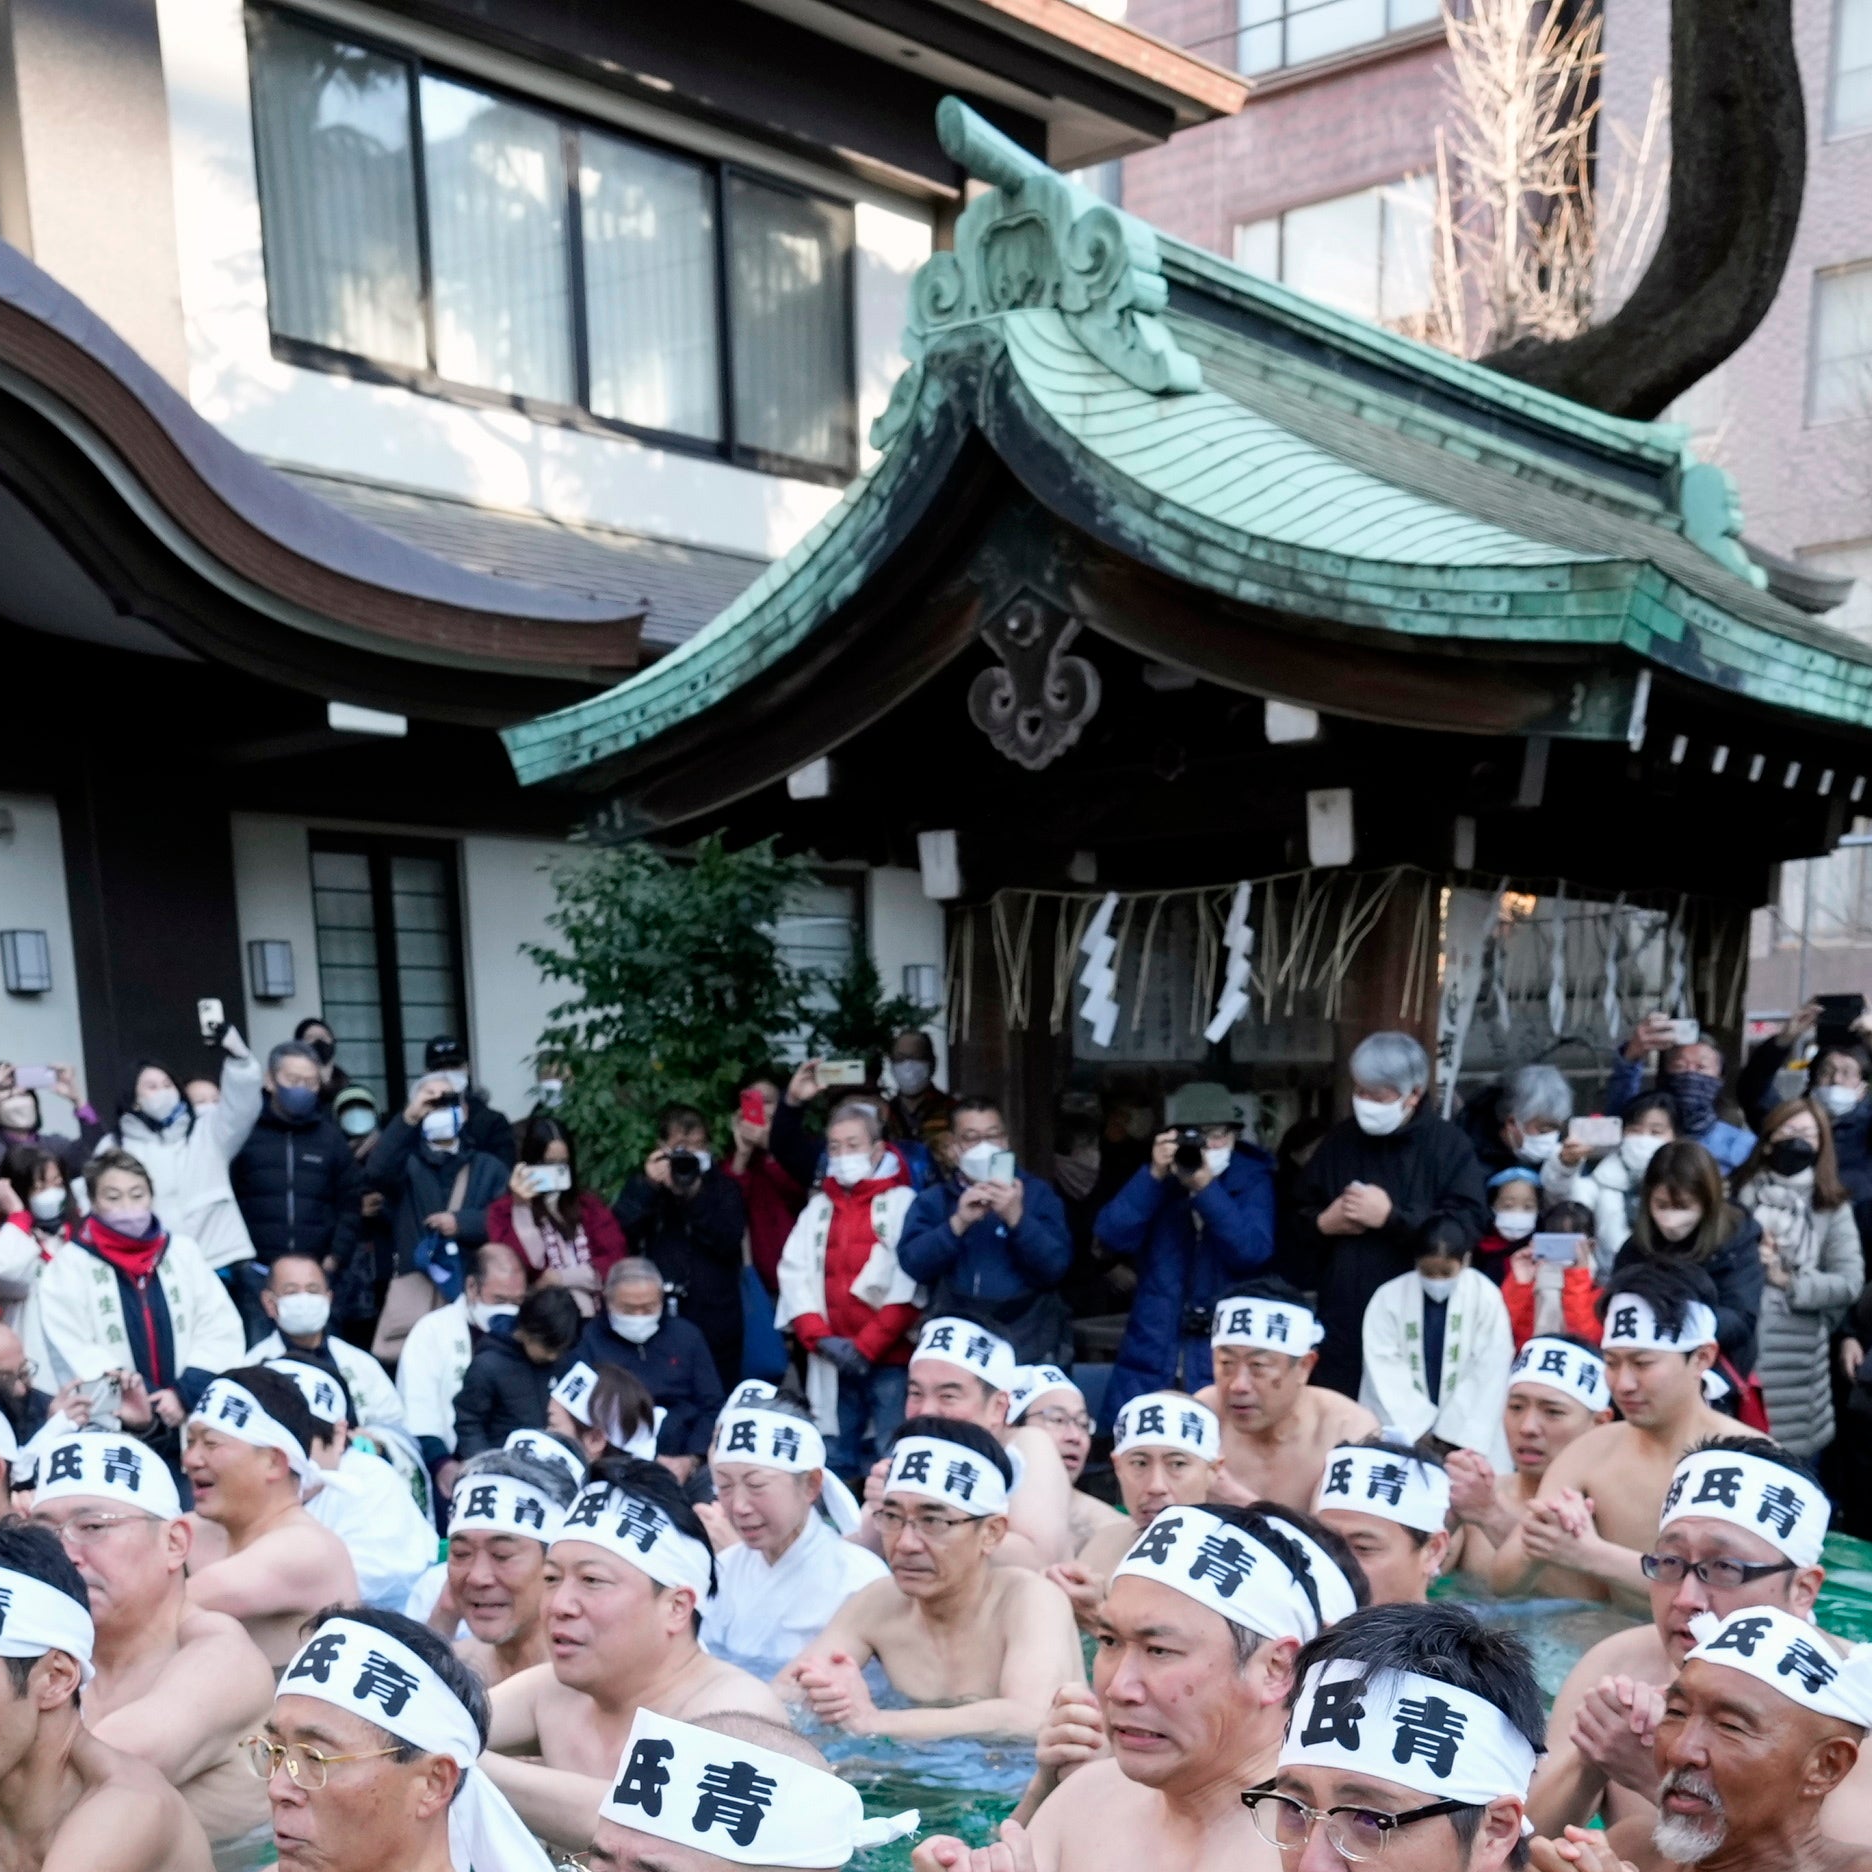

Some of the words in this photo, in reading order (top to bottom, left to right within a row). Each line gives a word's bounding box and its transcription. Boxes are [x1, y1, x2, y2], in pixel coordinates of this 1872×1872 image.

[898, 1451, 980, 1500] 氏青
[1326, 1458, 1407, 1505] 氏青
[1128, 1518, 1257, 1598] 氏青
[288, 1633, 420, 1717] 氏青
[1707, 1617, 1837, 1695] 氏青
[1301, 1678, 1468, 1779] 氏青
[613, 1738, 777, 1847] 氏青
